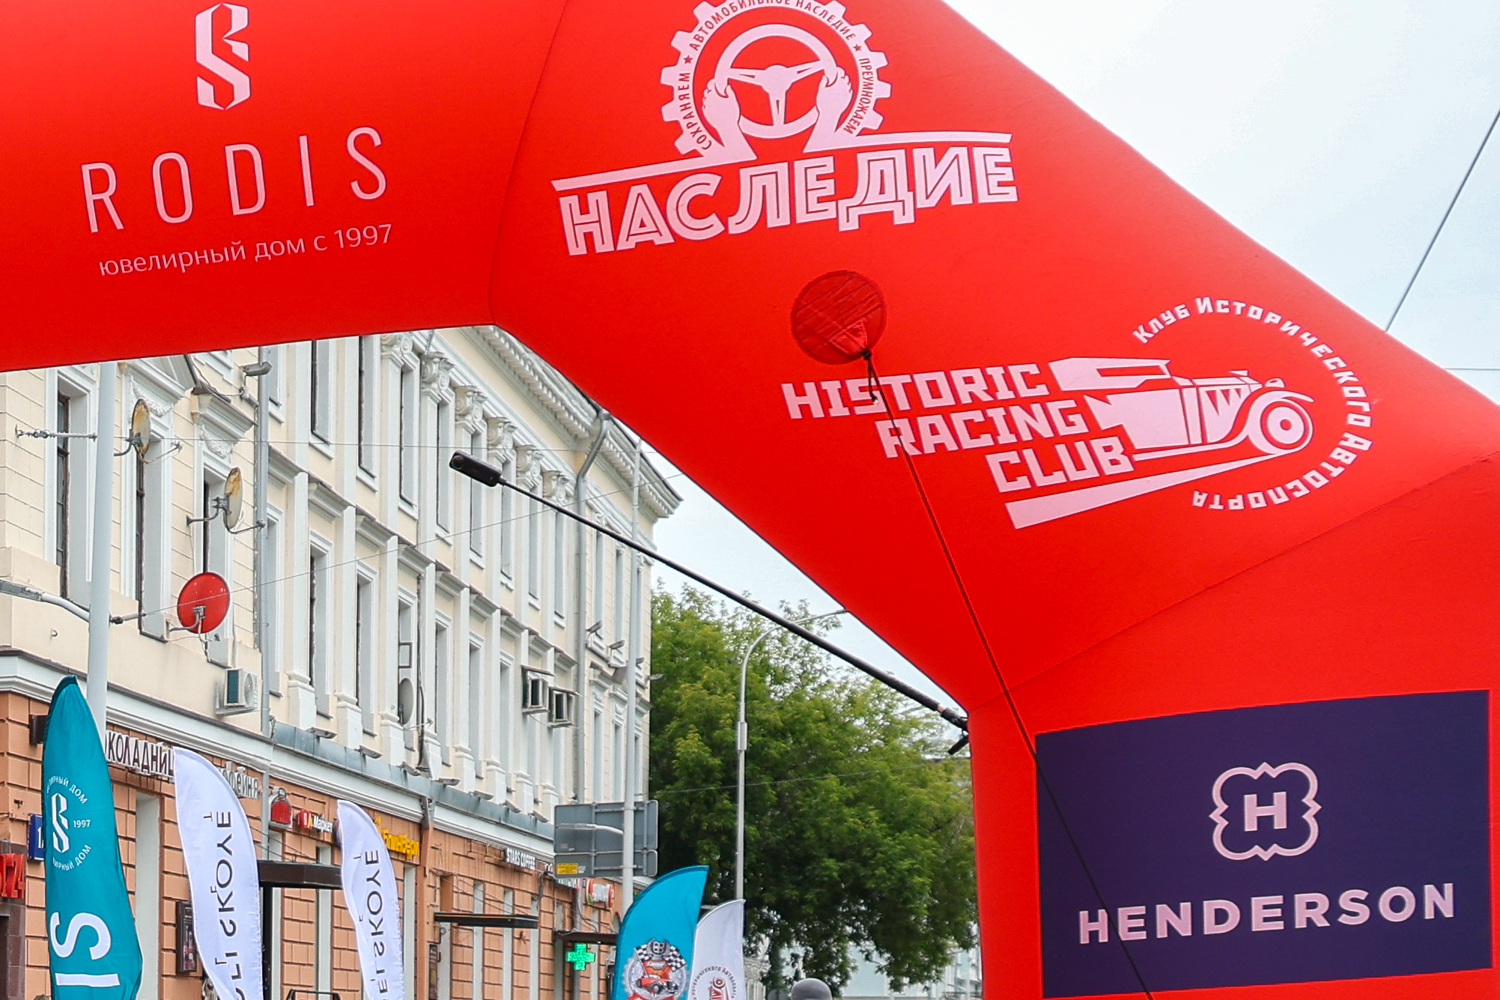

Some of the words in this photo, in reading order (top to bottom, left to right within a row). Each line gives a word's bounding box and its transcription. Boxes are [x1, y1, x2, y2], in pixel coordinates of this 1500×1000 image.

[678, 72, 712, 150] СОХРАНЯЕМ
[842, 57, 874, 135] ПРЕУМНОЖАЕМ
[80, 125, 388, 233] RODIS
[558, 146, 1019, 256] НАСЛЕДИЕ
[99, 241, 247, 277] ювелирный
[254, 236, 306, 262] дом
[334, 223, 393, 249] 1997
[780, 363, 1050, 419] HISTORIC
[876, 399, 1086, 458] RACING
[986, 436, 1135, 493] CLUB
[106, 730, 174, 778] КОЛАДНИ
[73, 819, 91, 828] 1997
[1243, 791, 1287, 831] H
[506, 847, 520, 866] STARS
[521, 852, 536, 870] COFFEE
[1079, 882, 1454, 944] HENDERSON
